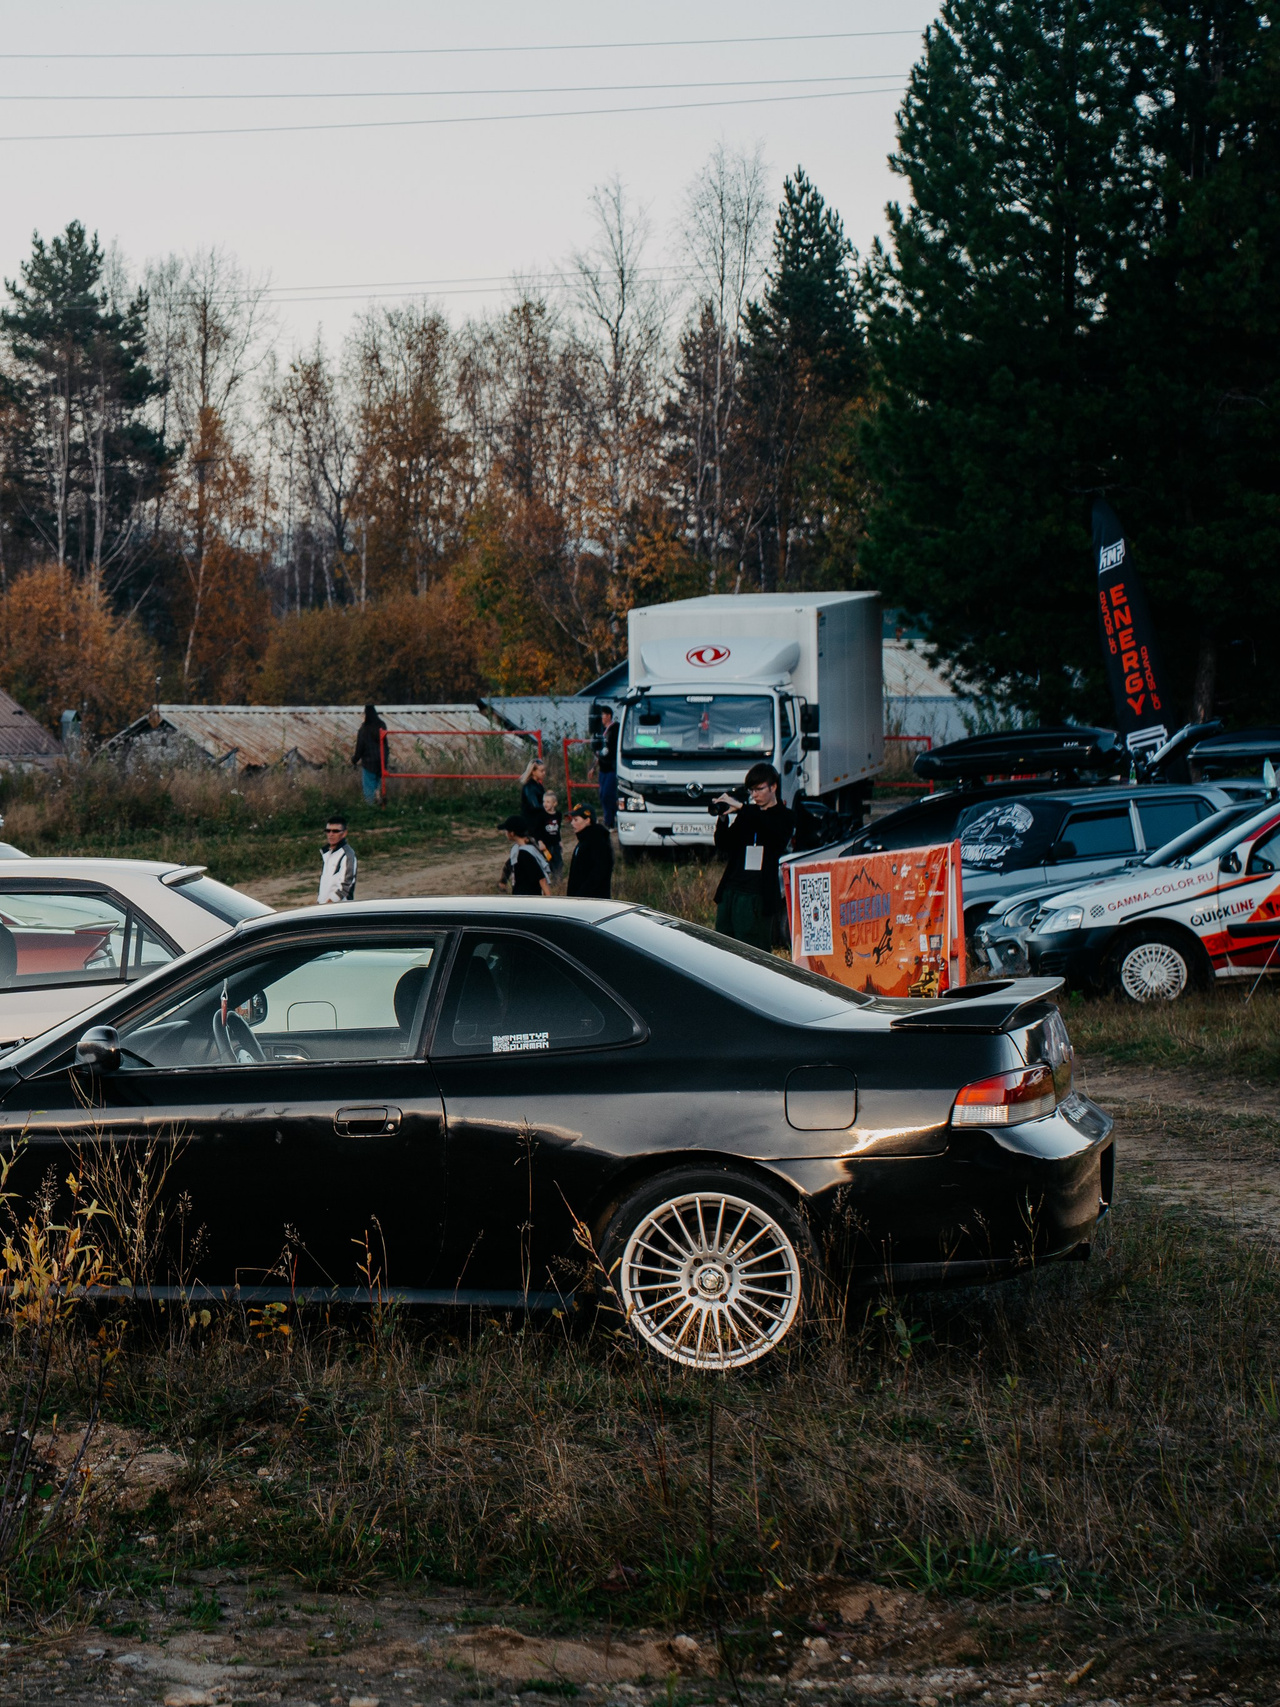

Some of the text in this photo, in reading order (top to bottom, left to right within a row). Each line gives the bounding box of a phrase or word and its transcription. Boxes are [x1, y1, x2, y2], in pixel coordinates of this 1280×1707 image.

[1100, 591, 1118, 655] OF SOUND
[1109, 583, 1146, 716] ENERGY
[1140, 645, 1162, 711] OF SOUND
[840, 892, 890, 926] SIBERIAN
[1107, 871, 1214, 912] GAMMA-COLOR.RU
[1190, 898, 1255, 927] QUICKLINE
[849, 920, 879, 948] EXPO
[509, 1032, 549, 1041] NASTYA
